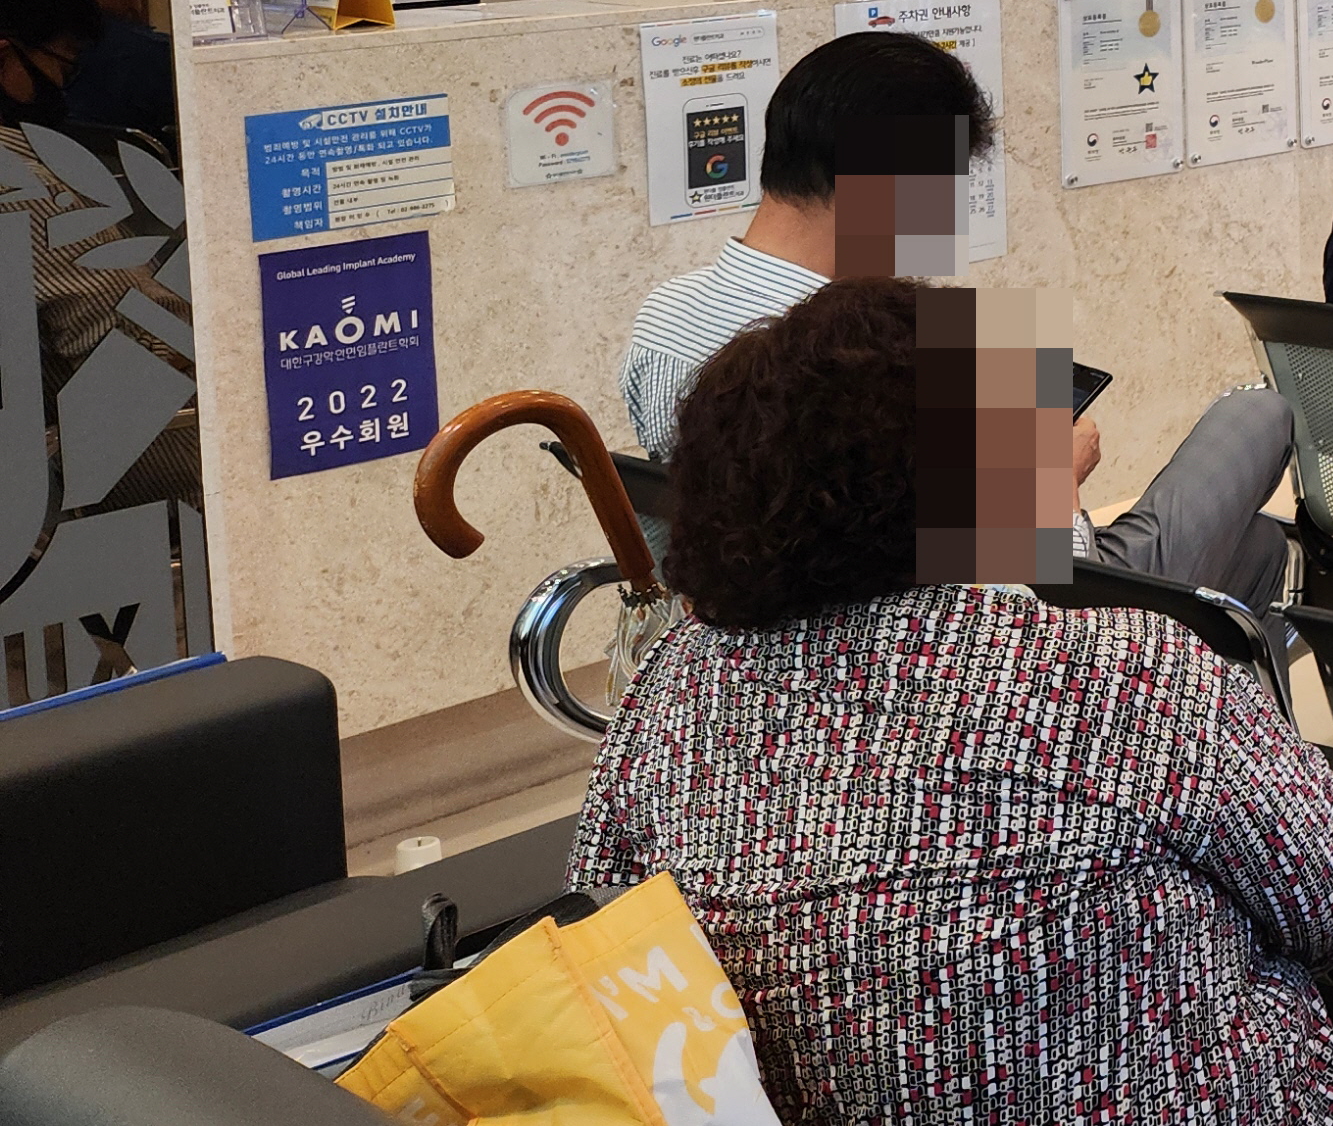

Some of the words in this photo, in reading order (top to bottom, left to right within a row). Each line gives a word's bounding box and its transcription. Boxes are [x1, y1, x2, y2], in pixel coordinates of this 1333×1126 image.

[899, 8, 929, 23] 주차권
[932, 4, 971, 20] 안내사항
[651, 34, 687, 48] Google
[327, 110, 369, 126] CCTV
[374, 103, 427, 121] 설치안내
[264, 140, 299, 153] 범죄예방
[381, 127, 396, 138] 위해
[399, 124, 432, 135] CCTV가
[264, 153, 295, 165] 24시간
[377, 140, 393, 150] 되고
[397, 136, 433, 148] 있습니다.
[281, 184, 322, 198] 촬영시간
[283, 201, 323, 216] 촬영범위
[294, 219, 323, 230] 책임자
[276, 269, 305, 280] Global
[306, 264, 341, 277] Leading
[343, 258, 376, 272] Implant
[377, 252, 416, 266] Academy
[279, 309, 419, 352] KAOMI
[300, 412, 410, 457] 우수회원
